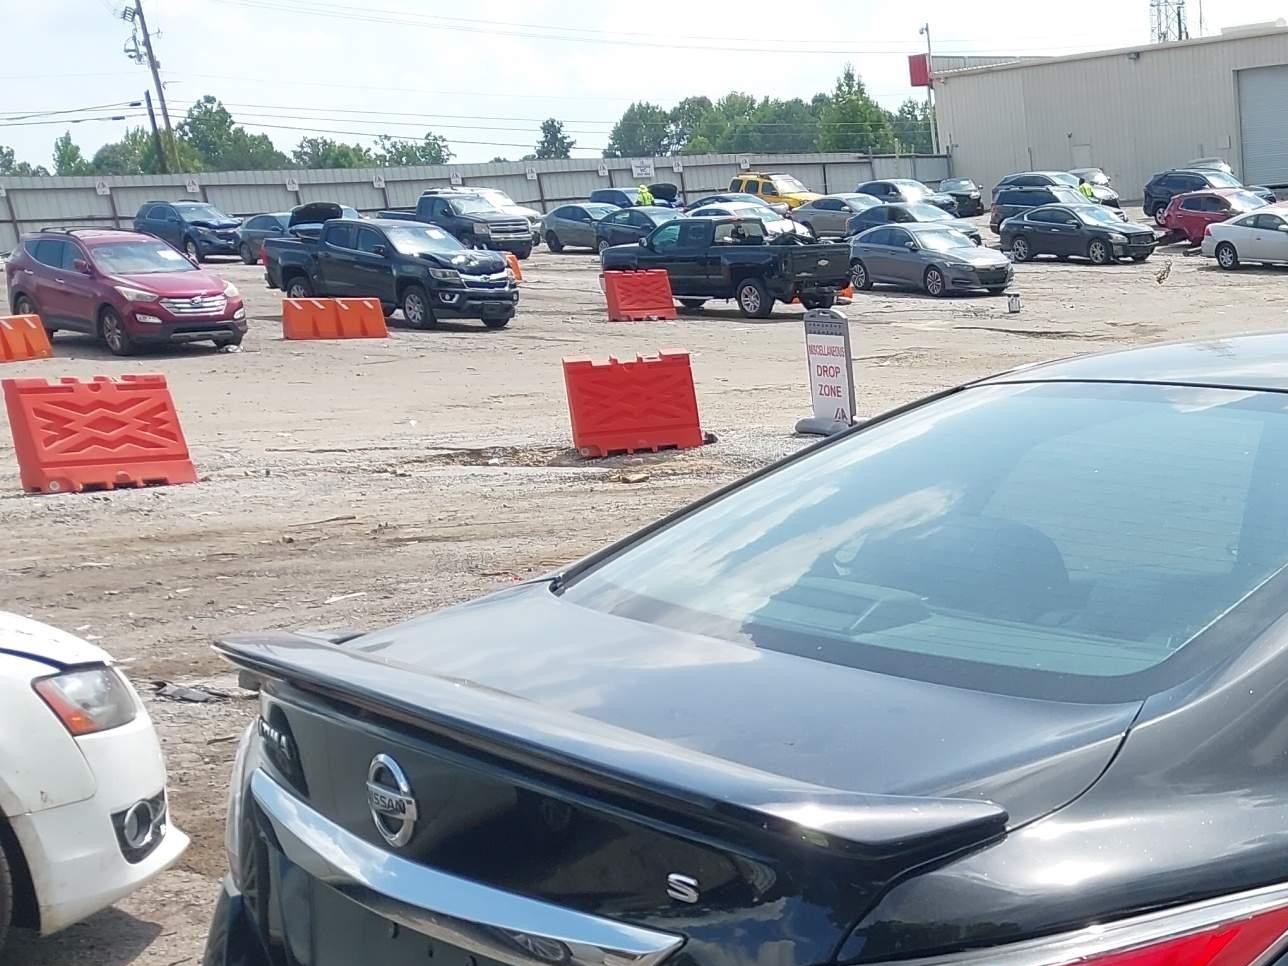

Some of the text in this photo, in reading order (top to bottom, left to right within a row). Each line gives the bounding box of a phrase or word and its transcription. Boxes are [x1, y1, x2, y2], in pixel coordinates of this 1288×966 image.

[816, 364, 841, 378] DROP
[818, 384, 842, 398] ZONE
[666, 872, 699, 904] S
